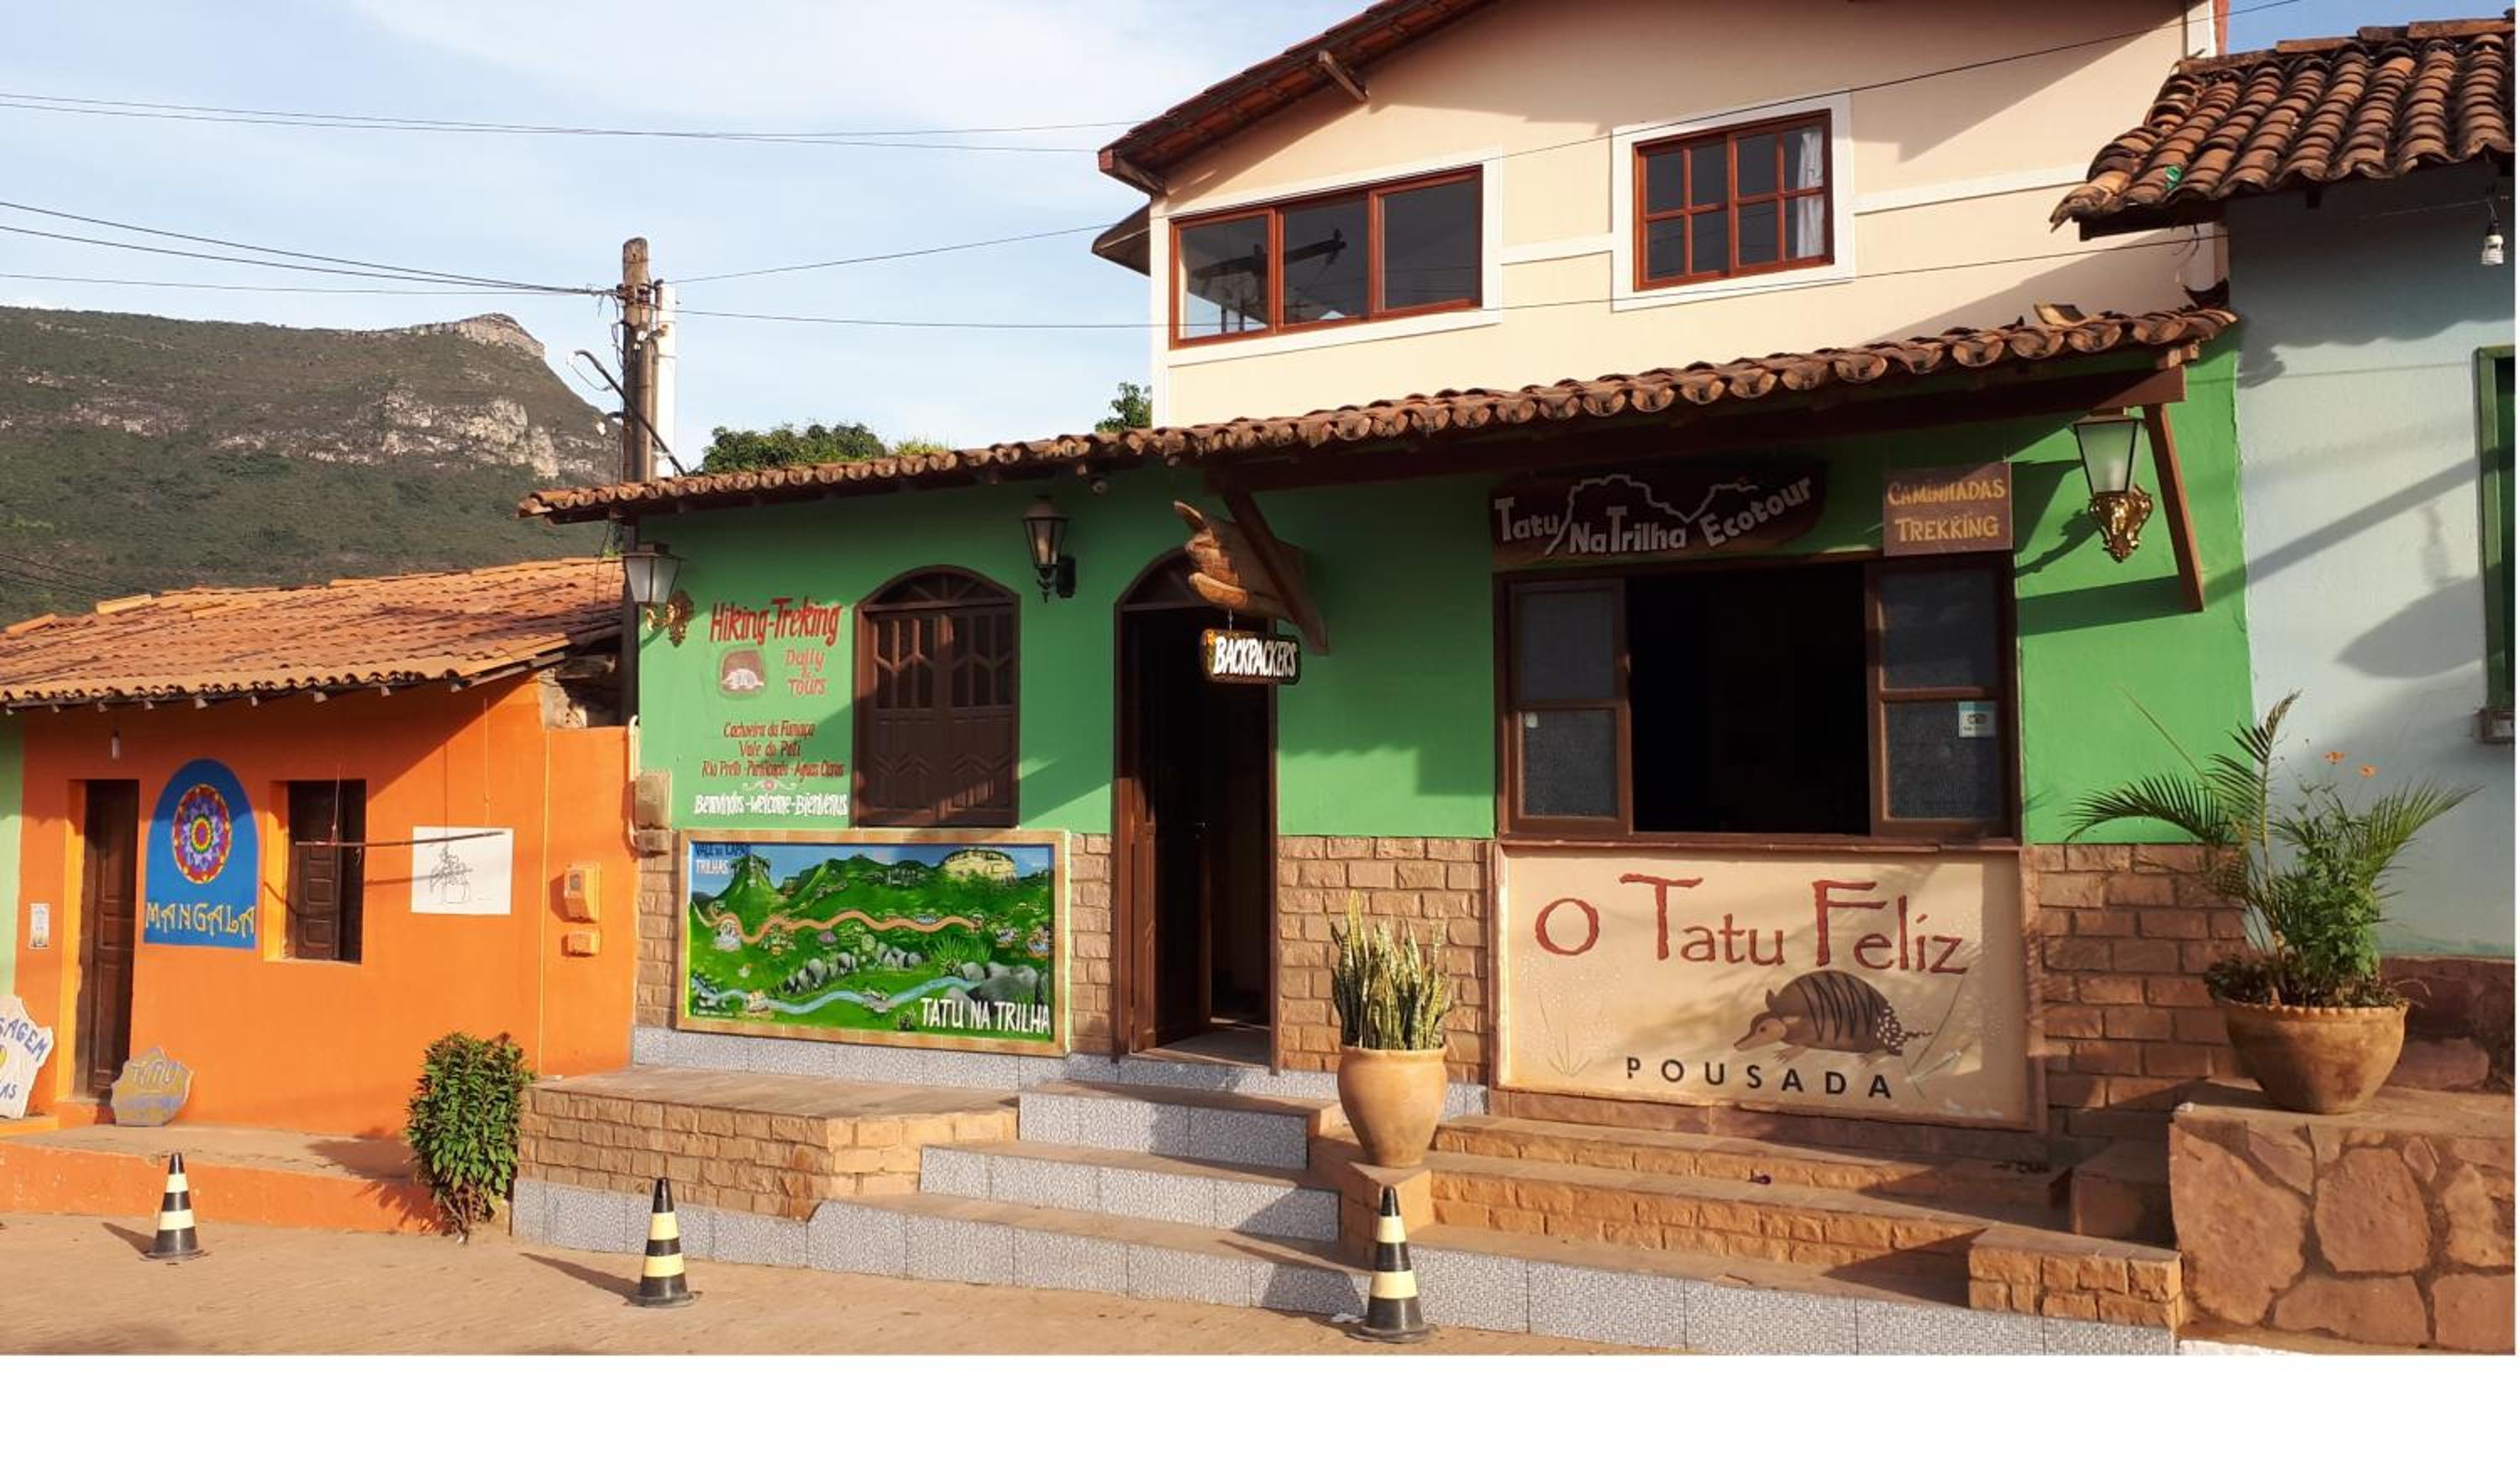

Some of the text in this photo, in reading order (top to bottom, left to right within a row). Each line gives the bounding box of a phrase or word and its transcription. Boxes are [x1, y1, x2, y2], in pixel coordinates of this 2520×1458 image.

[1494, 496, 1559, 542] Tatu
[1698, 477, 1812, 548] Ecotour
[1894, 514, 1999, 543] TREKKING
[1212, 635, 1298, 677] BACKPACKERS
[696, 859, 729, 874] TRILHAS
[145, 902, 256, 938] MANGALA
[1534, 898, 1599, 956] O
[1620, 873, 1786, 967] Tatu
[920, 997, 1052, 1036] TATU NA TRILHA
[1626, 1056, 1893, 1099] POUSADA
